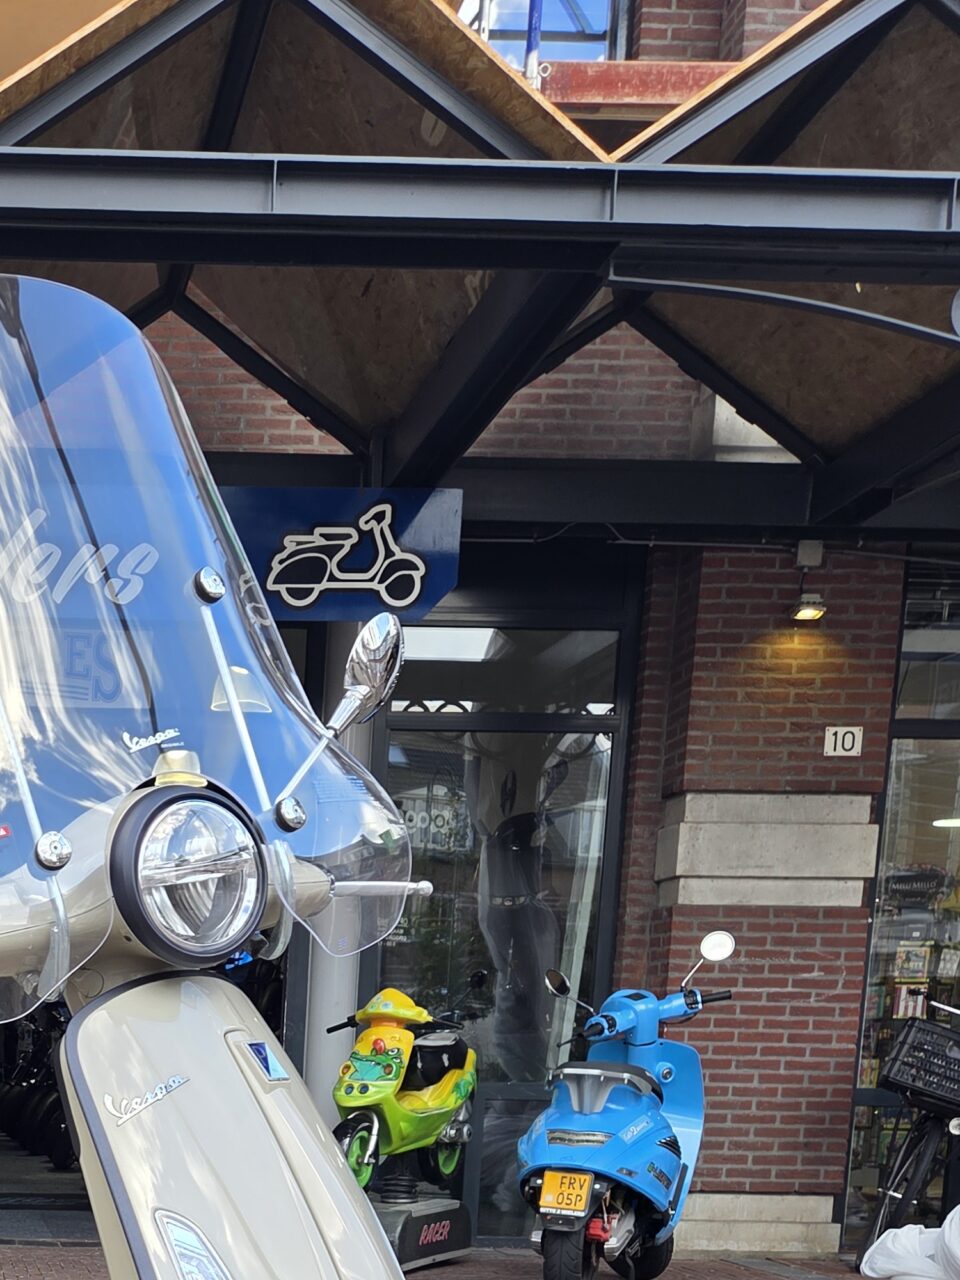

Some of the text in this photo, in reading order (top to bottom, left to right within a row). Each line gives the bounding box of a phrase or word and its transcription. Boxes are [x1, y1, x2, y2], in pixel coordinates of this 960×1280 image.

[122, 728, 181, 753] Vespa
[832, 730, 856, 752] 10
[103, 1074, 191, 1128] Vespa
[559, 1175, 587, 1191] FRV
[556, 1192, 583, 1207] 05P
[418, 1220, 451, 1247] RACER
